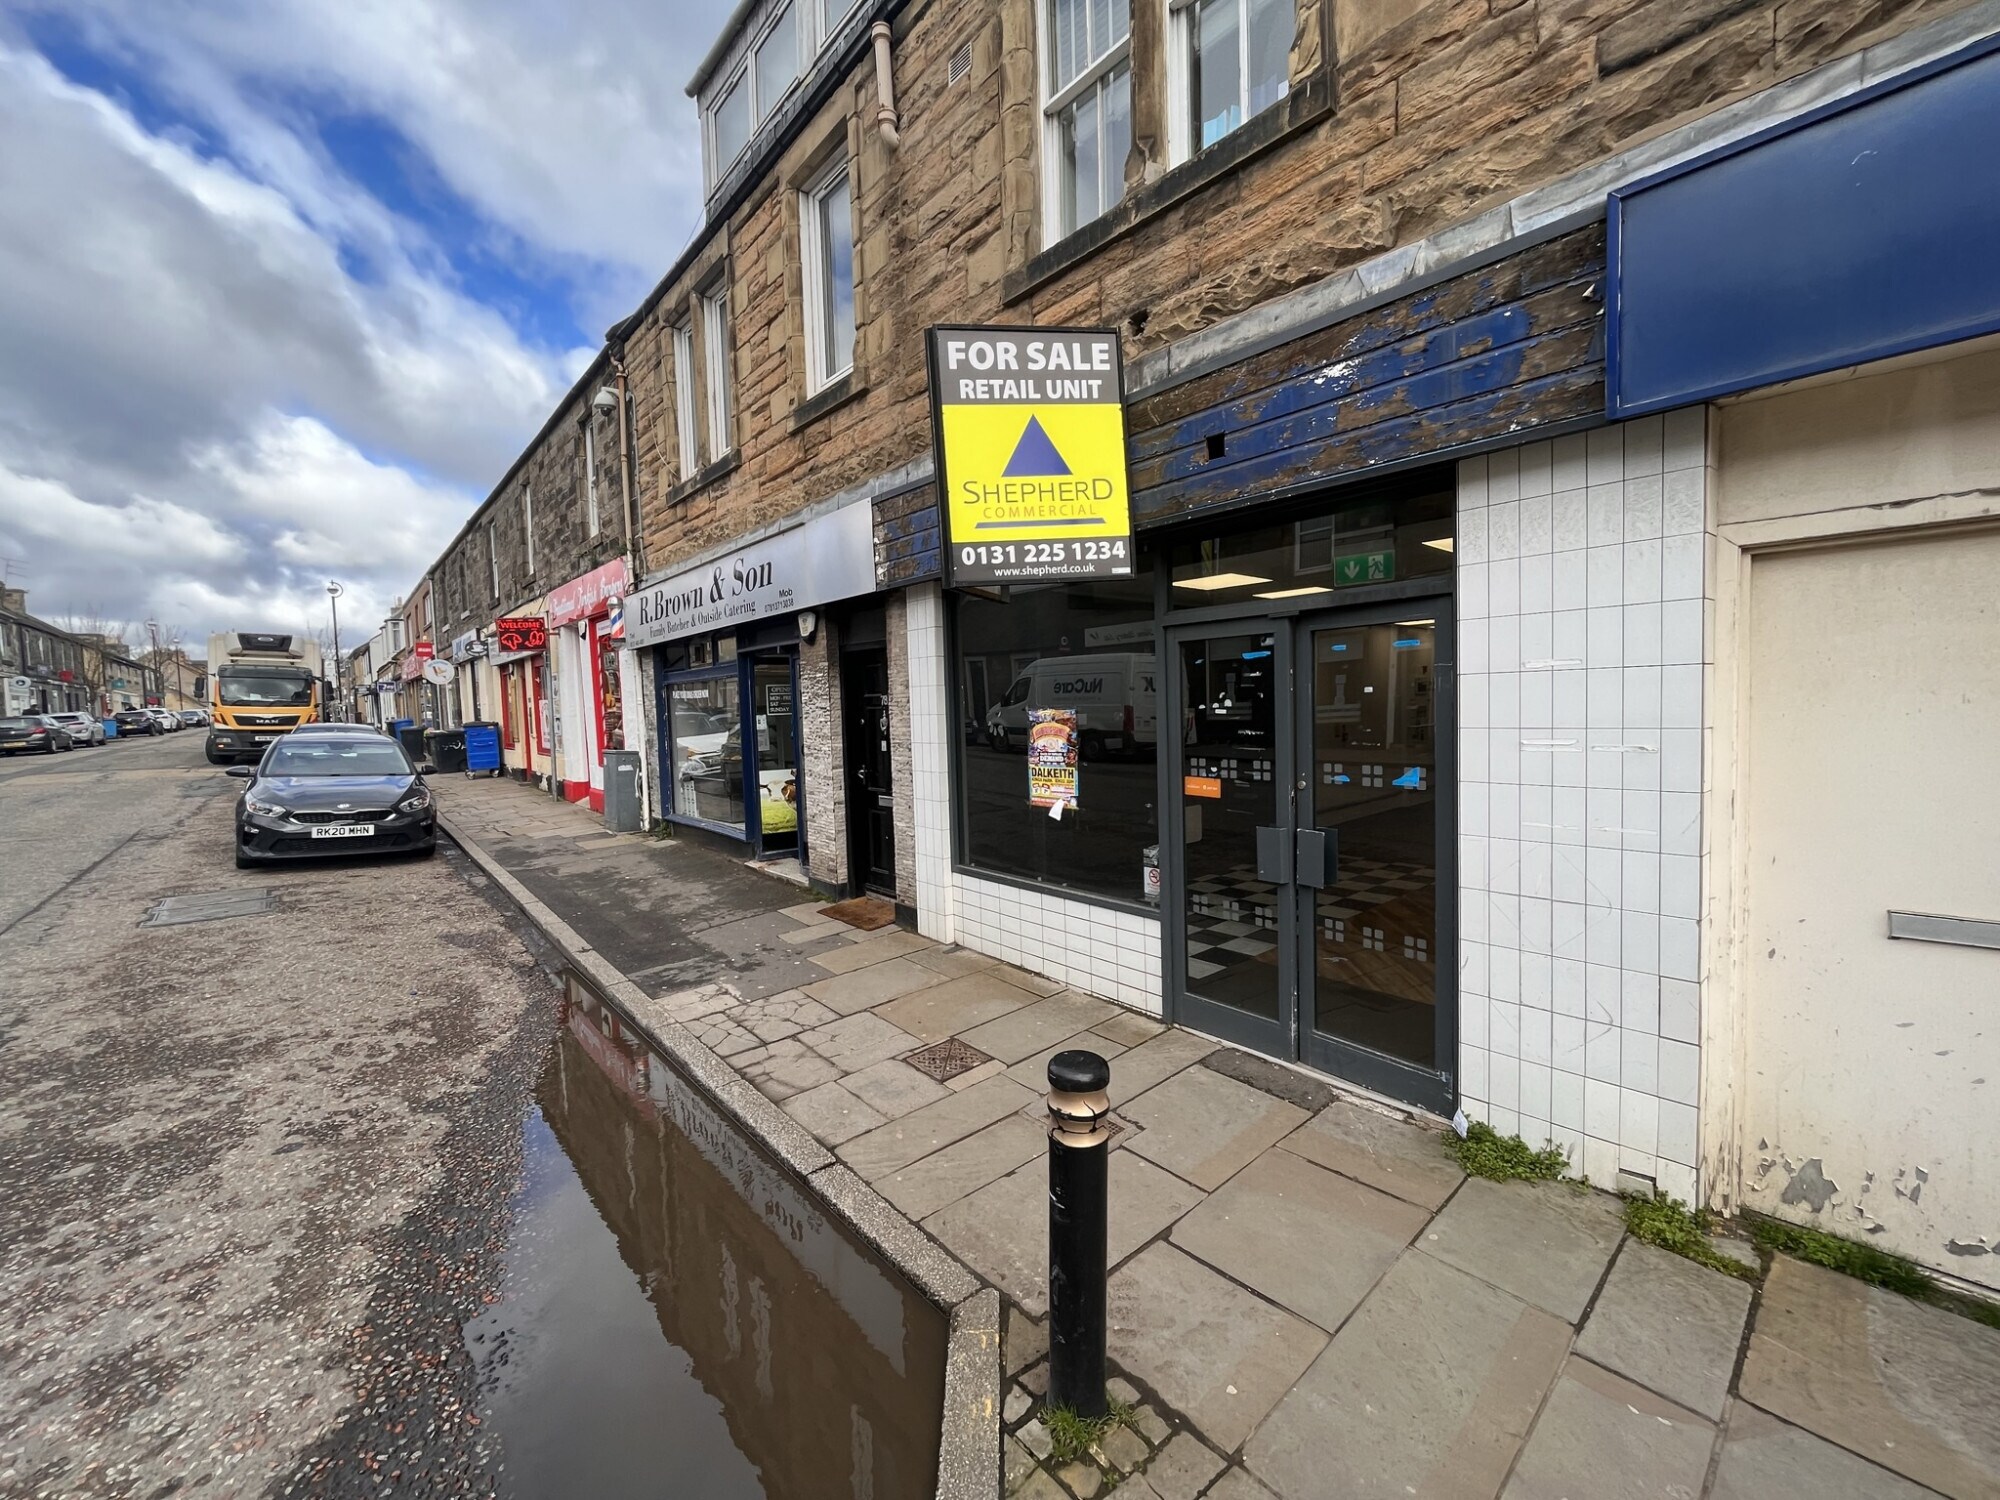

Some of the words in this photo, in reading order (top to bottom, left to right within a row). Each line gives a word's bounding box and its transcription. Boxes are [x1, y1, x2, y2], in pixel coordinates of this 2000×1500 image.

[947, 341, 1020, 371] FOR
[1026, 342, 1111, 371] SALE
[959, 378, 1041, 399] RETAIL
[1046, 379, 1102, 399] UNIT
[963, 478, 1113, 505] SHEPHERD
[983, 504, 1097, 519] COMMERCIAL
[961, 546, 1017, 566] 0131
[1024, 543, 1066, 563] 225
[1071, 540, 1126, 561] 1234
[994, 562, 1096, 577] www.shepherd.co.uk
[639, 586, 703, 626] R.Brown
[709, 566, 726, 604] &
[731, 557, 773, 597] Son
[778, 587, 793, 599] Mob
[500, 621, 541, 629] WELCOME
[649, 619, 666, 639] Family
[667, 616, 690, 635] Butcher
[690, 613, 697, 627] &
[697, 606, 722, 626] Outside
[723, 598, 756, 619] Catering
[880, 694, 889, 706] 78
[1031, 767, 1074, 779] DALKEITH
[316, 827, 346, 836] RK20
[348, 826, 370, 835] MHN
